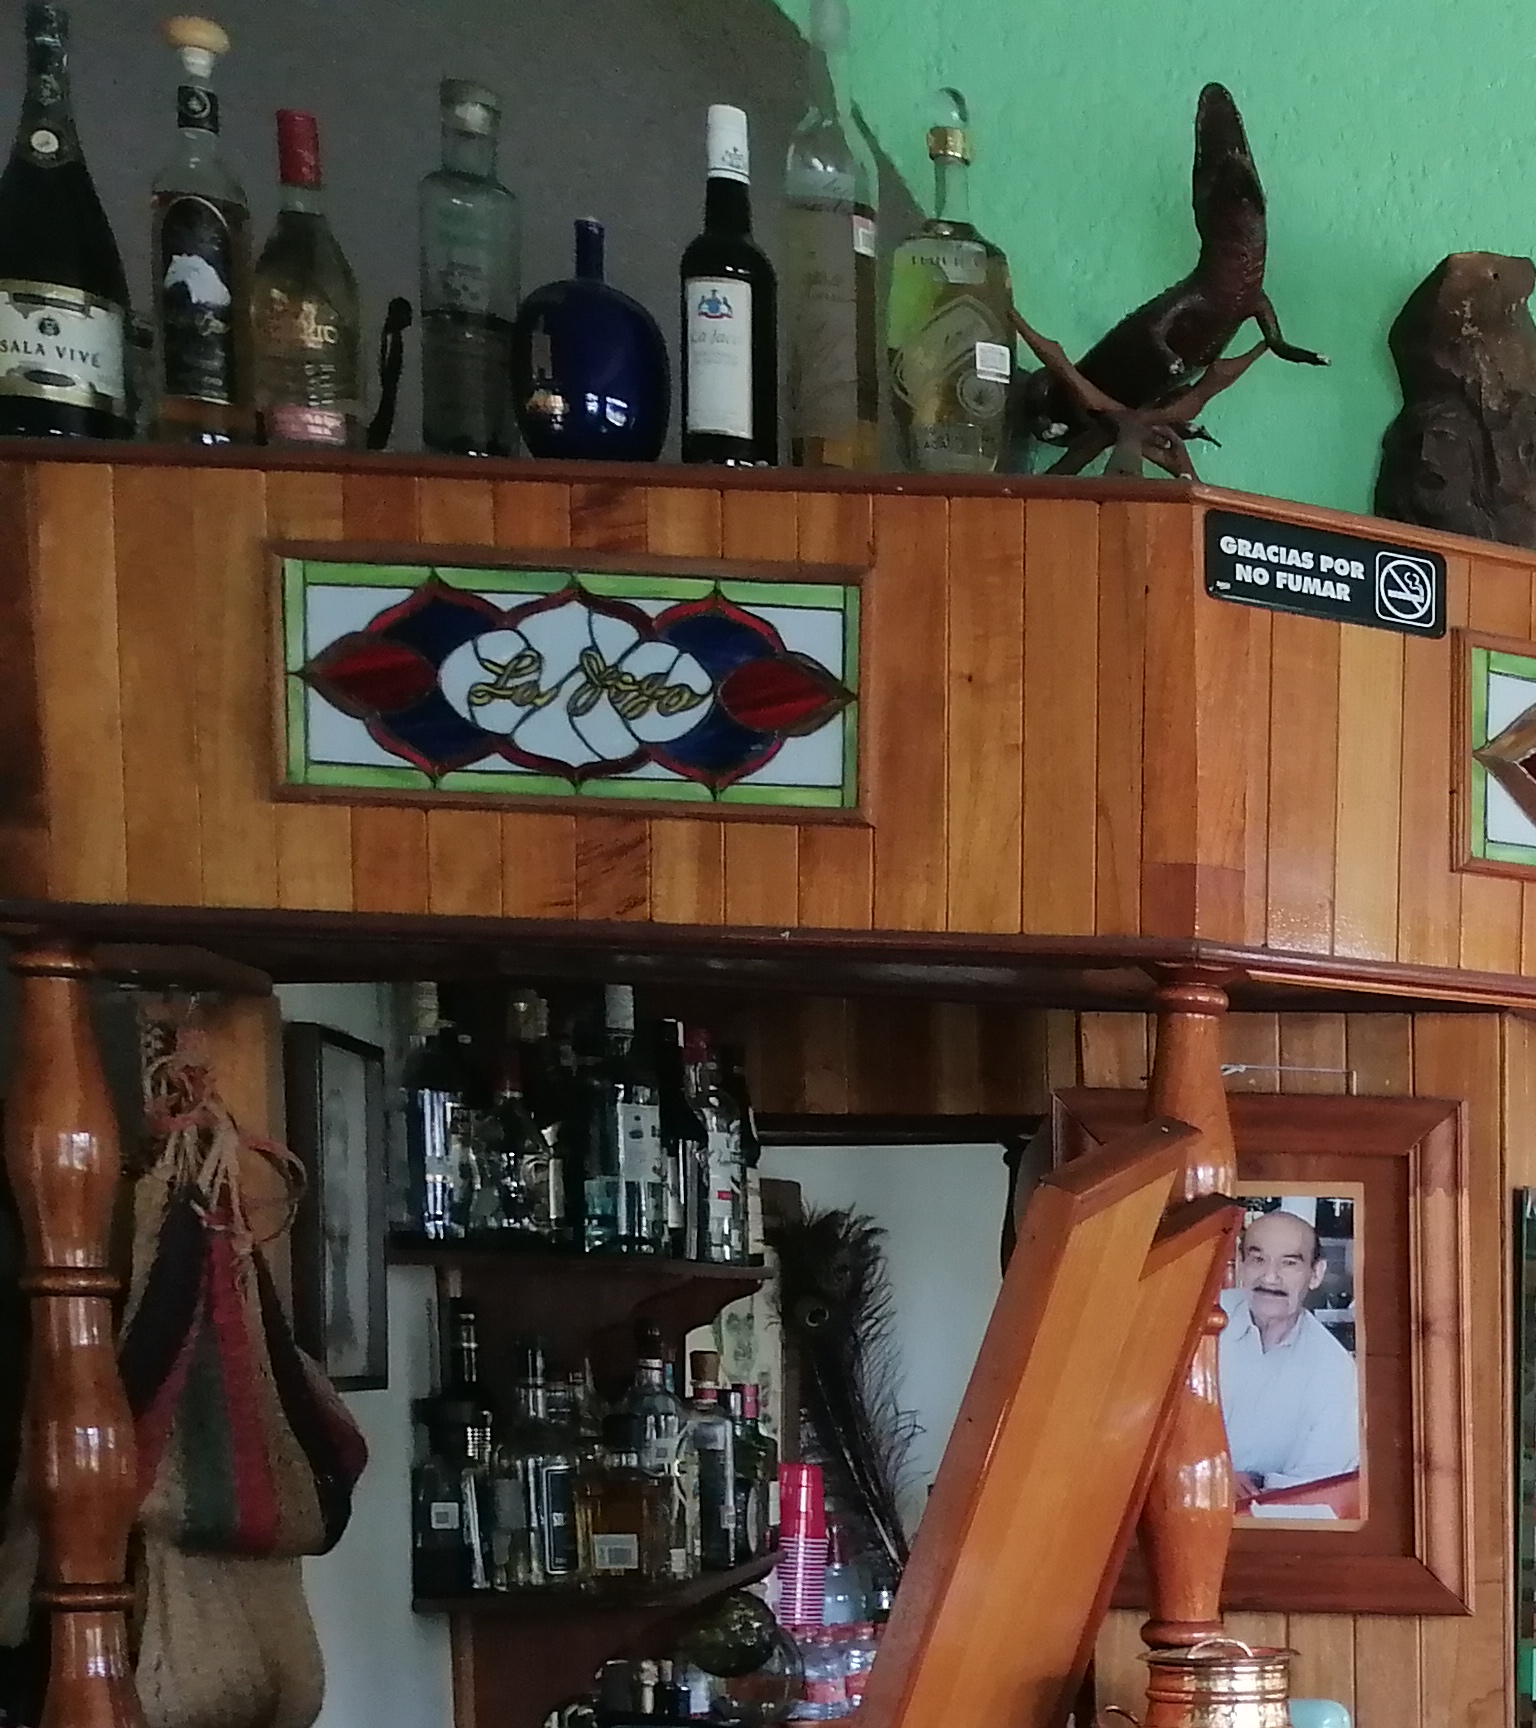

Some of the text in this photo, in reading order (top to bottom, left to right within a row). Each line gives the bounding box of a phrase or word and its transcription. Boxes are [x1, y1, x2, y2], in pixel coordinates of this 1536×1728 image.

[0, 339, 45, 356] SALA
[1219, 535, 1365, 580] GRACIAS POR
[1235, 563, 1351, 602] NO FUMAR
